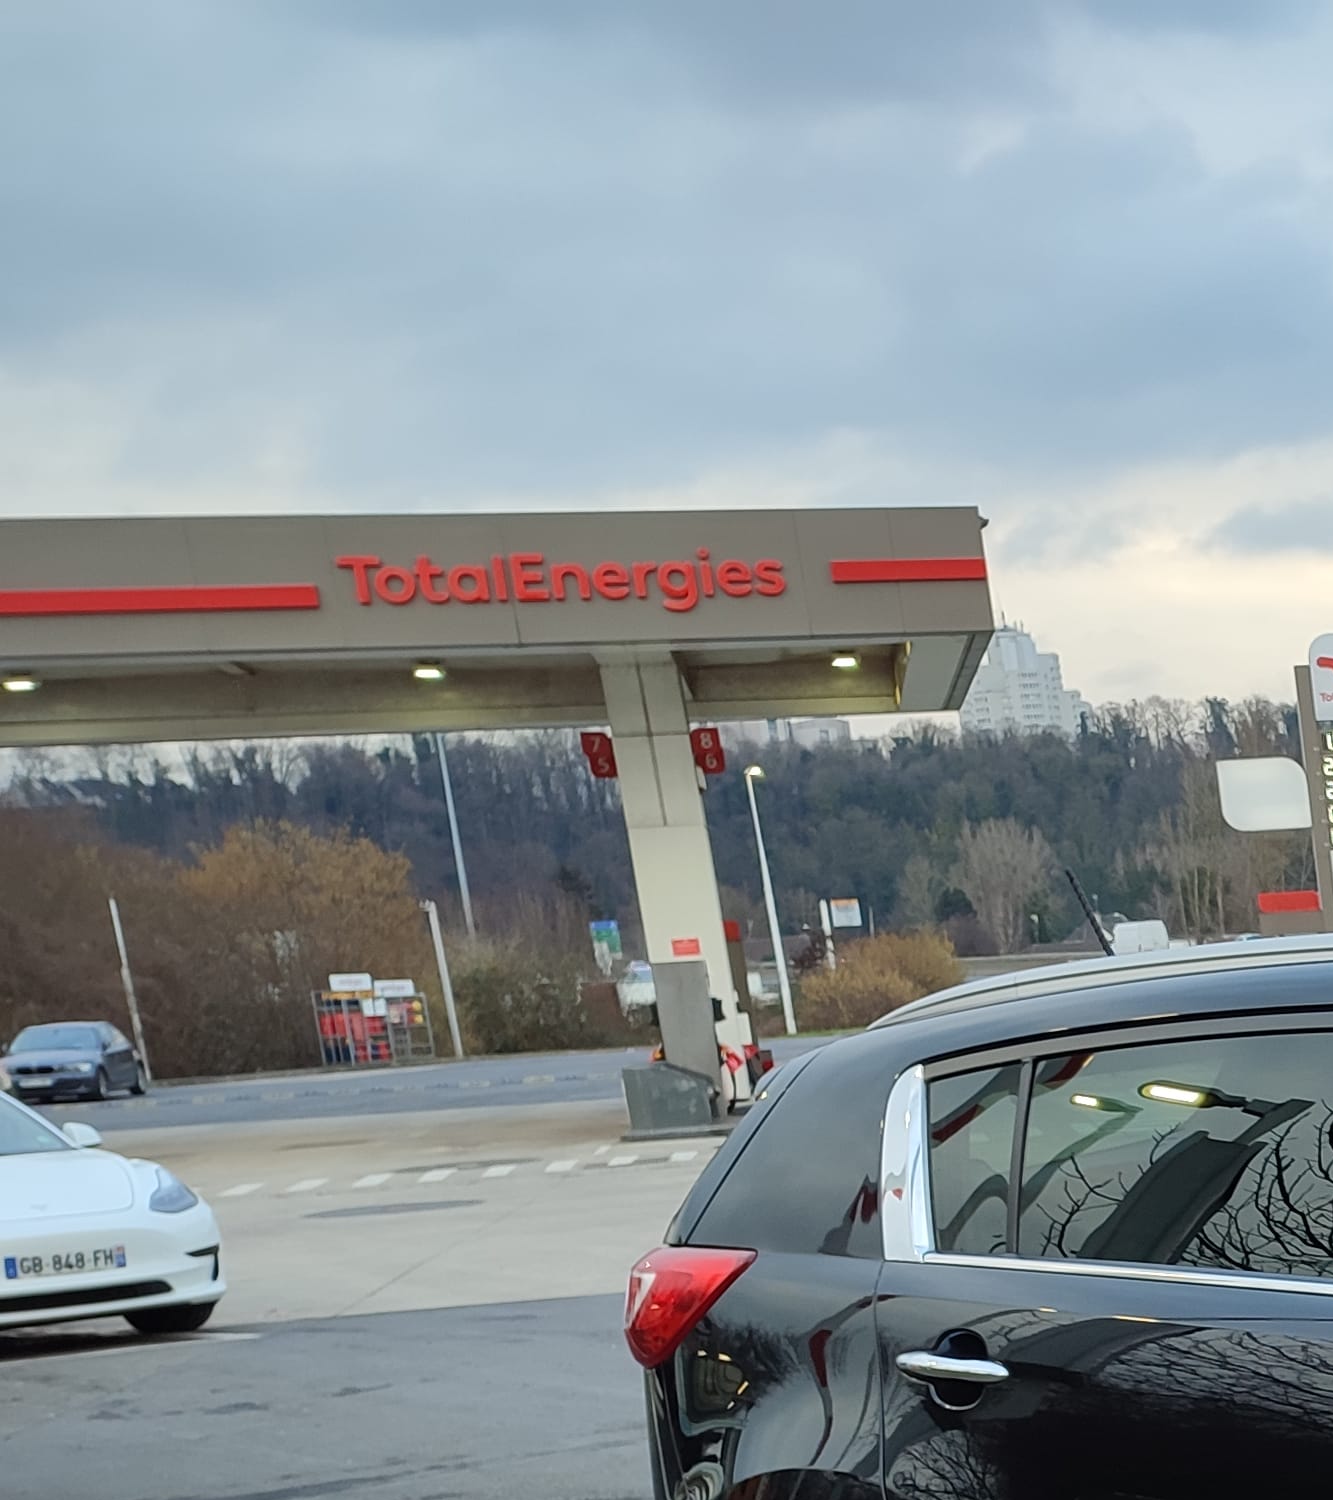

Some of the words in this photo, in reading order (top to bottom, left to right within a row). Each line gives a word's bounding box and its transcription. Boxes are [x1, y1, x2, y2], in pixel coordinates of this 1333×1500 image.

[336, 547, 786, 612] TotalEnergies
[590, 736, 601, 753] 7
[699, 732, 713, 749] 8
[704, 753, 717, 769] 6
